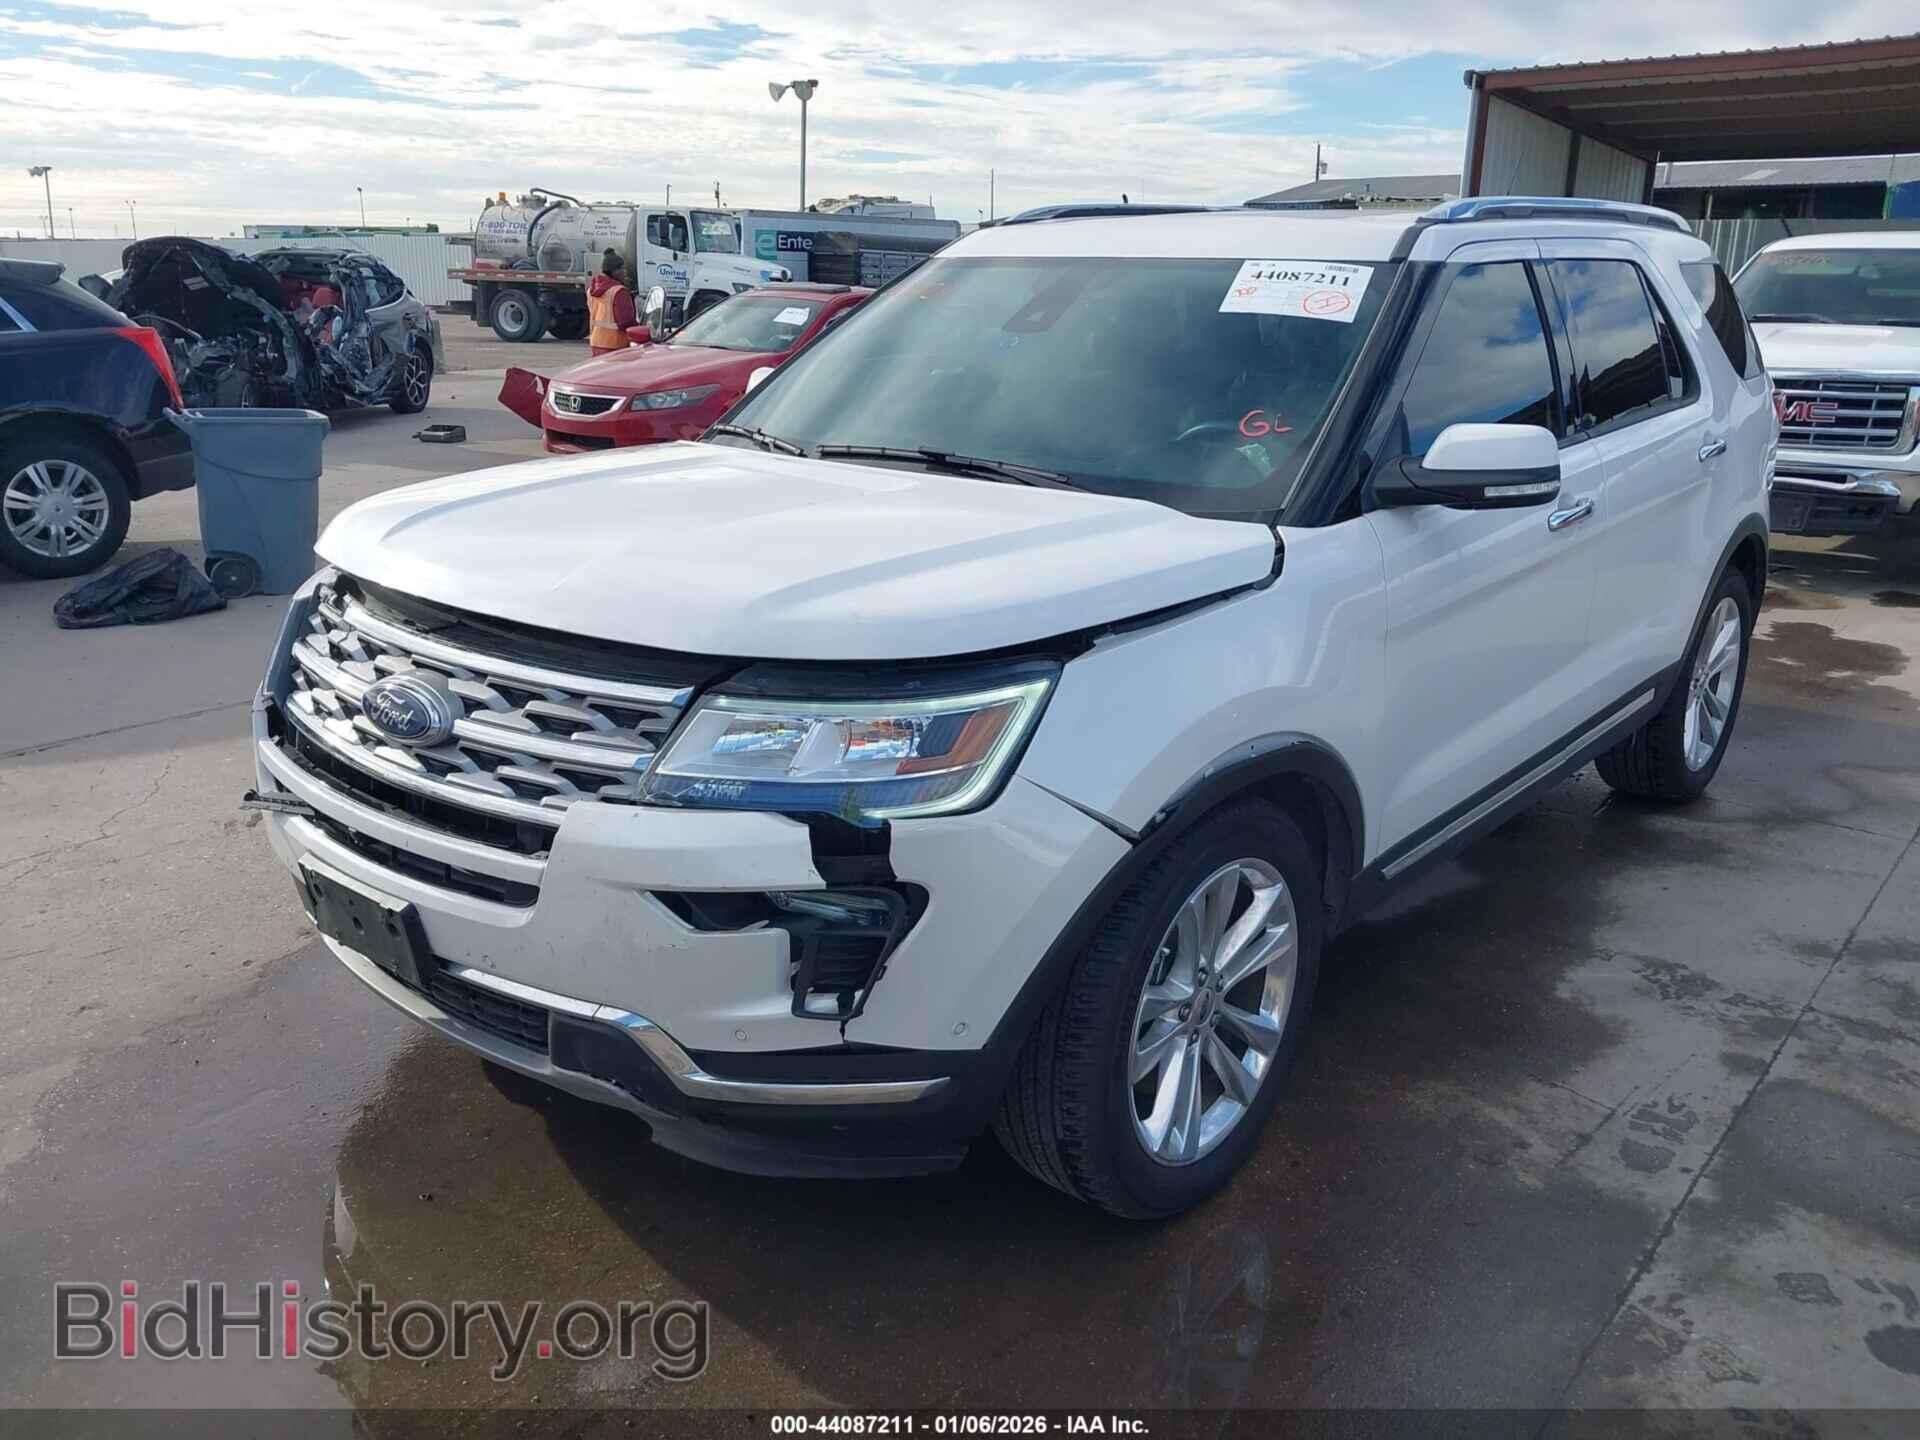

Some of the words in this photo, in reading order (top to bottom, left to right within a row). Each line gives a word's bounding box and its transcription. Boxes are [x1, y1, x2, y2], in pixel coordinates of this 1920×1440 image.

[480, 221, 545, 231] 1-800-TOILTS
[778, 234, 813, 249] Ente
[660, 267, 687, 277] United
[1250, 270, 1350, 286] 44087211
[1780, 401, 1838, 422] MC
[1240, 410, 1295, 437] GL
[371, 691, 415, 731] Ford
